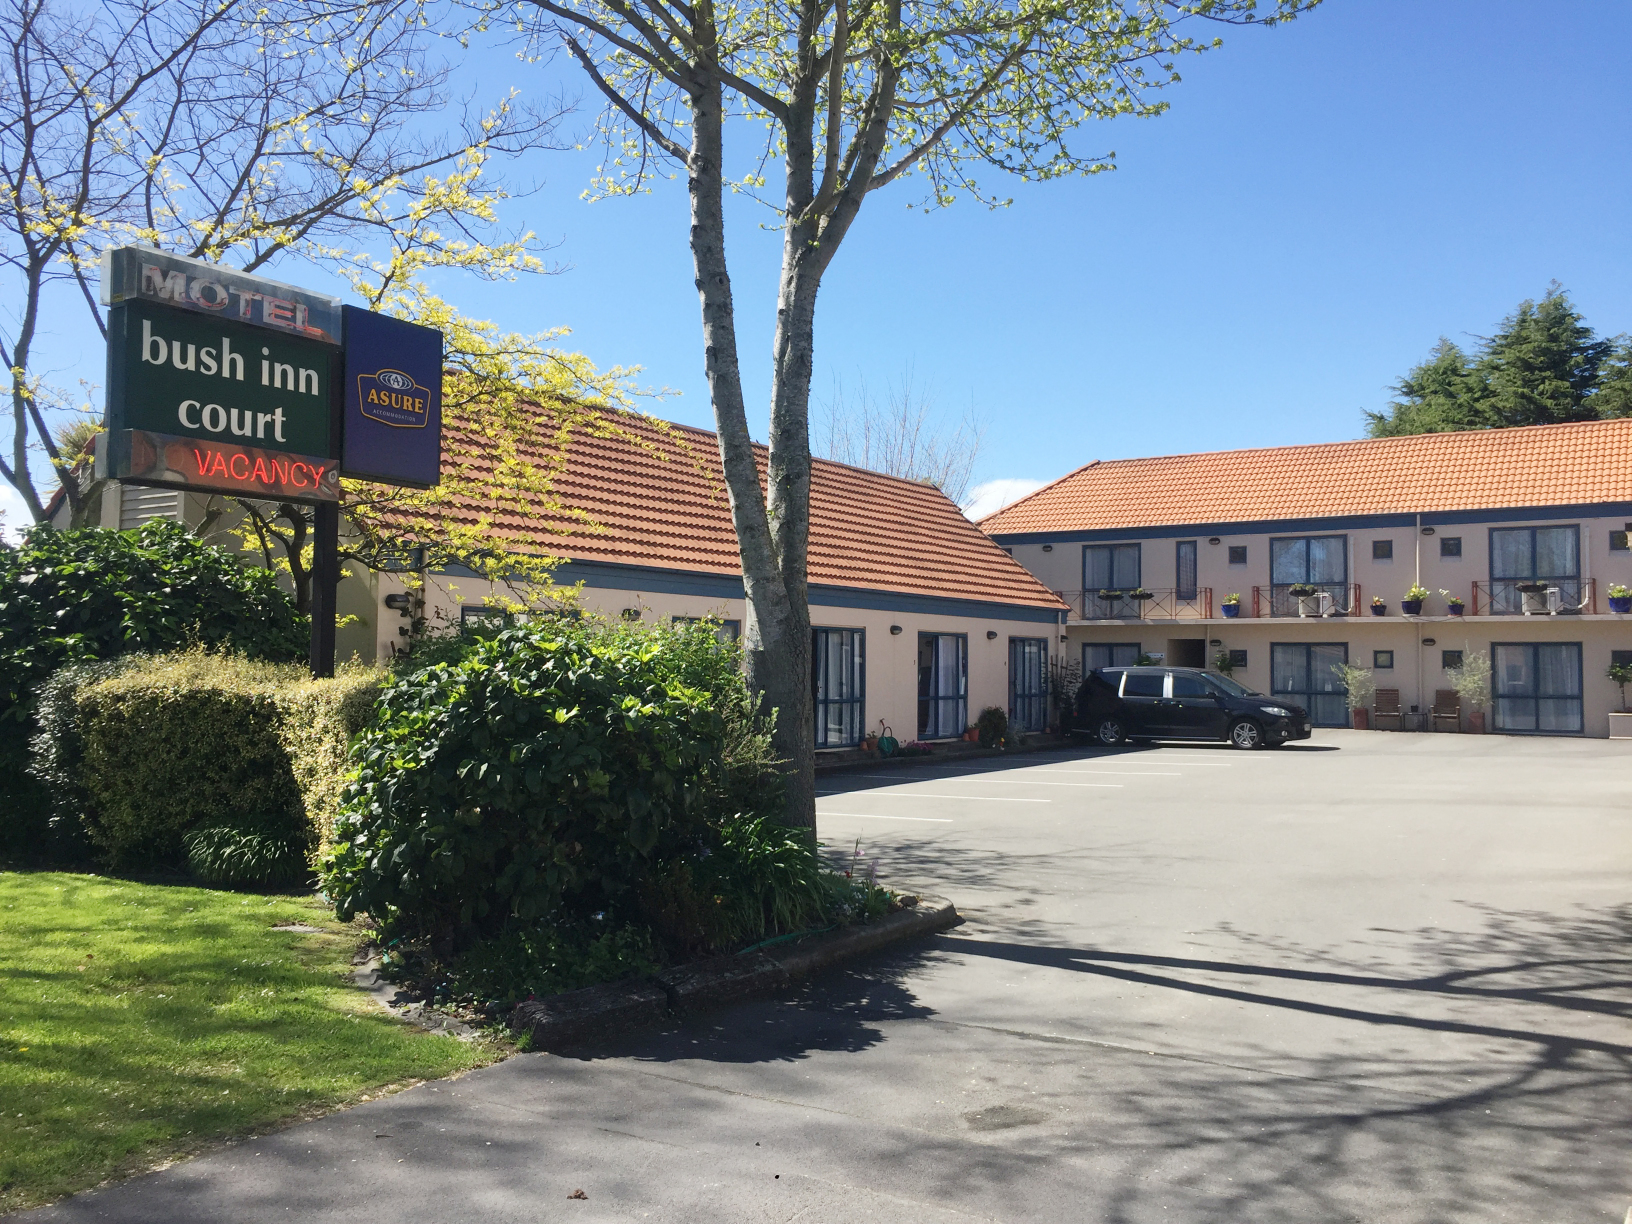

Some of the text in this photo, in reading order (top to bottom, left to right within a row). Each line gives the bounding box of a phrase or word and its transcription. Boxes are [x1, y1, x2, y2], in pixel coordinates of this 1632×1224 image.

[141, 263, 324, 334] MOTEL
[142, 319, 319, 396] bush inn
[367, 388, 424, 413] ASURE
[372, 408, 416, 422] ACCOMMODATION
[178, 400, 287, 443] court
[194, 449, 325, 489] VACANCY
